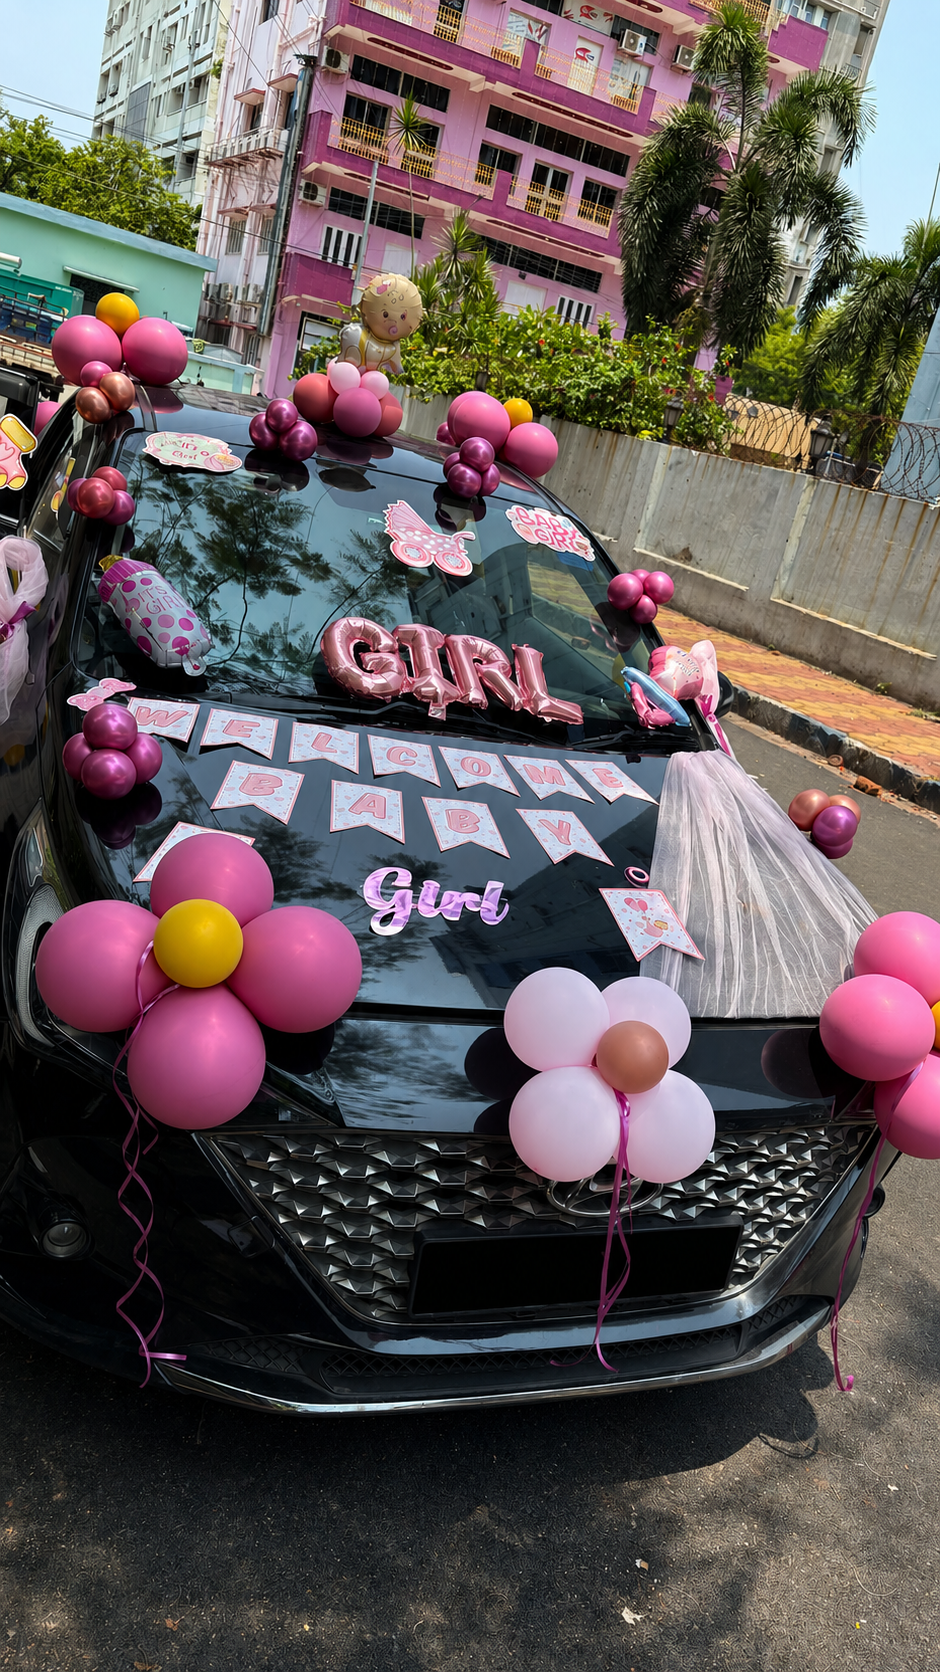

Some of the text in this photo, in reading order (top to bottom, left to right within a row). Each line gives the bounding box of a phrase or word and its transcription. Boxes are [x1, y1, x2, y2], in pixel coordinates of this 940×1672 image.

[534, 528, 580, 551] GIRL
[138, 585, 167, 602] IT'S
[321, 617, 583, 725] GIRL
[135, 706, 624, 789] WELCOME
[239, 773, 571, 846] BABY
[363, 866, 510, 936] Girl
